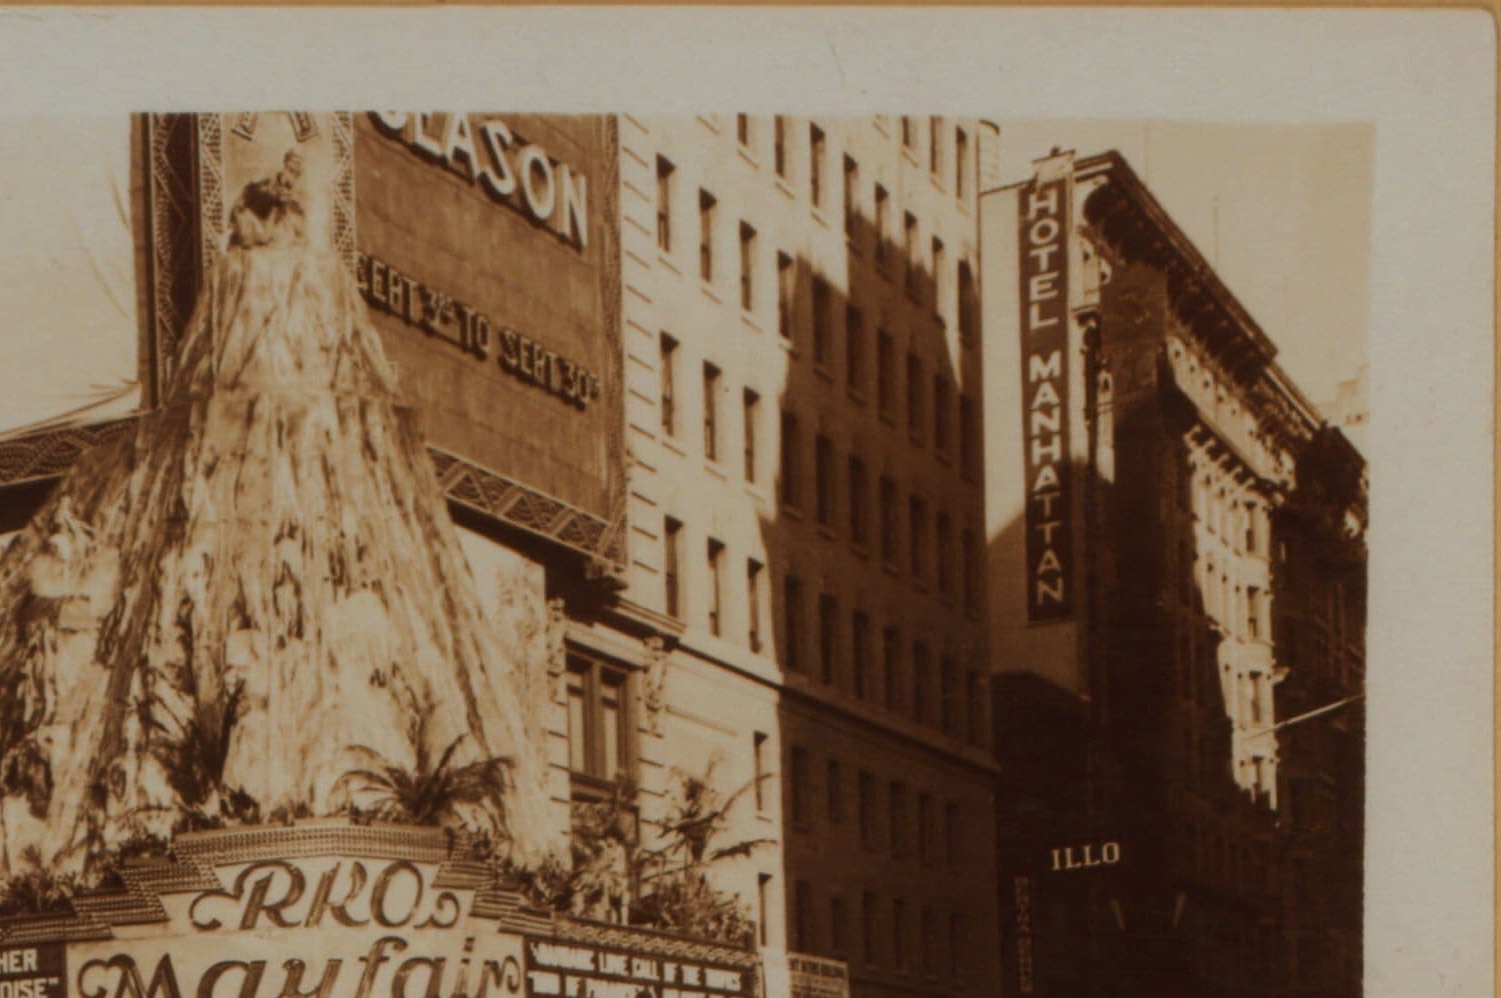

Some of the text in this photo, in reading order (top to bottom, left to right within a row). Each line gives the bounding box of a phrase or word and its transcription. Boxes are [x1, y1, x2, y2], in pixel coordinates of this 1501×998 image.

[1028, 186, 1065, 606] HOTEL MANHATTAN
[189, 859, 461, 931] RKO
